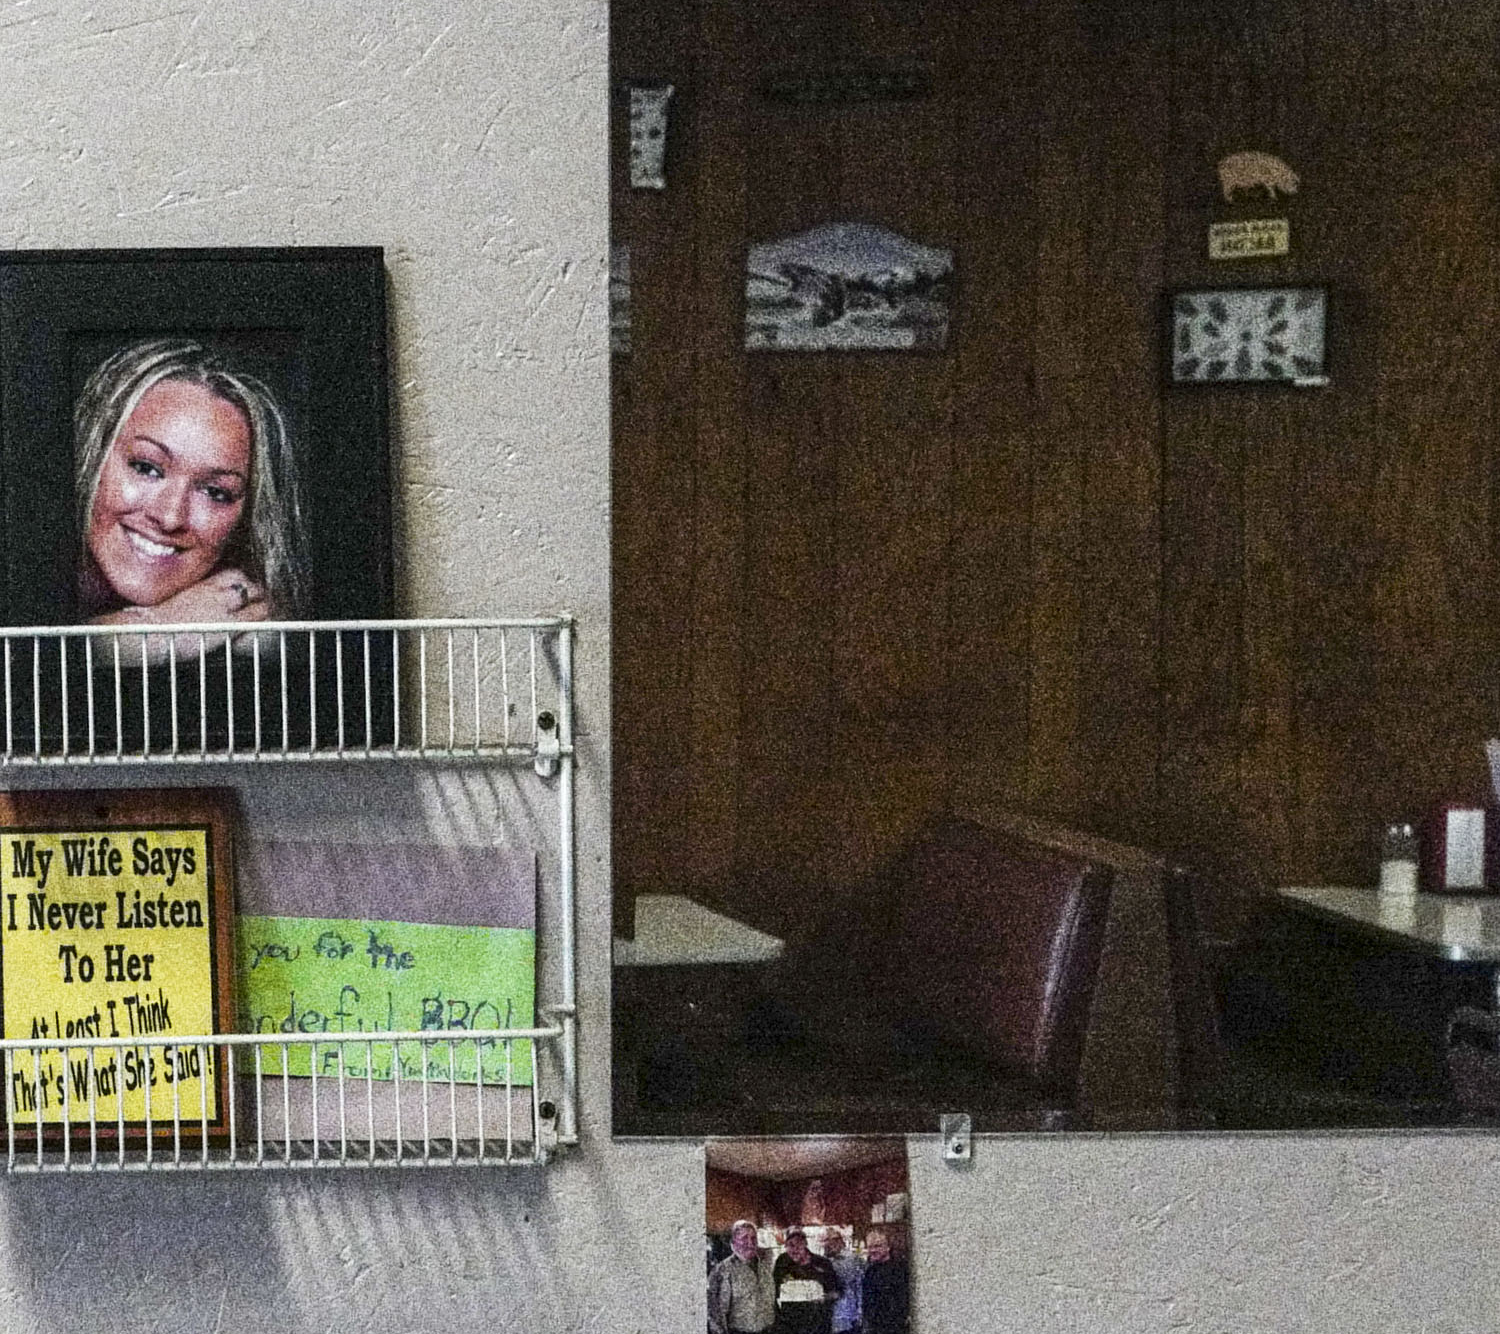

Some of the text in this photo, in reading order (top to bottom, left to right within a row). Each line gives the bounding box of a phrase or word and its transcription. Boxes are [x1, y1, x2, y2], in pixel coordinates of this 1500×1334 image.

[11, 837, 197, 889] My Wife Says
[7, 889, 204, 931] I Never Listen
[58, 944, 155, 983] To Her
[250, 941, 300, 971] you
[106, 999, 120, 1038] I
[123, 987, 173, 1037] Think
[237, 984, 393, 1035] onderful
[11, 1062, 66, 1114] That's
[69, 1056, 118, 1104] What
[124, 1045, 158, 1092] She
